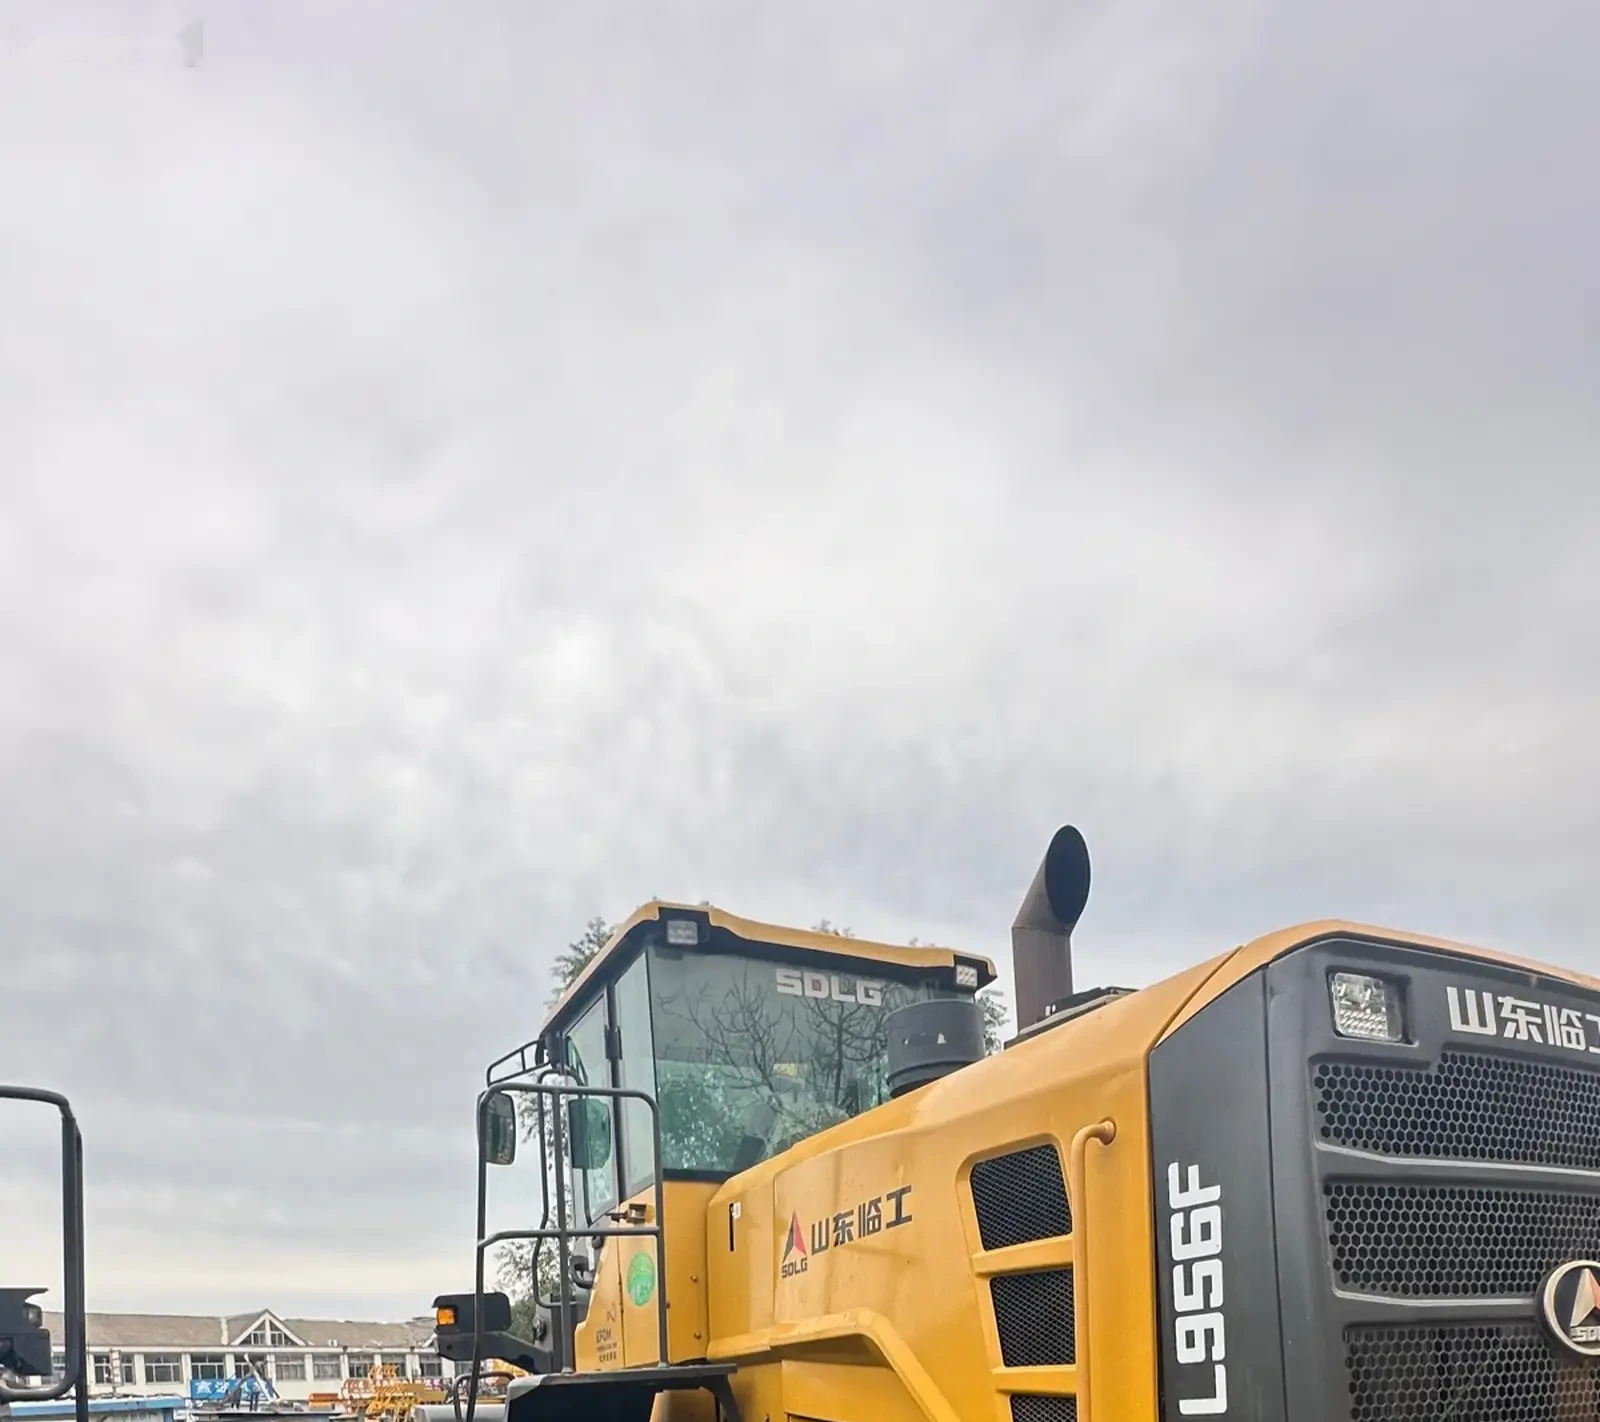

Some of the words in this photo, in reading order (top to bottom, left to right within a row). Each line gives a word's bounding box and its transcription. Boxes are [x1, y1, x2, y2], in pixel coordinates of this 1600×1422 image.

[776, 968, 882, 1006] SDLG
[811, 1185, 913, 1256] 山东临工
[781, 1257, 808, 1278] SDLG
[1168, 1162, 1228, 1416] L956F
